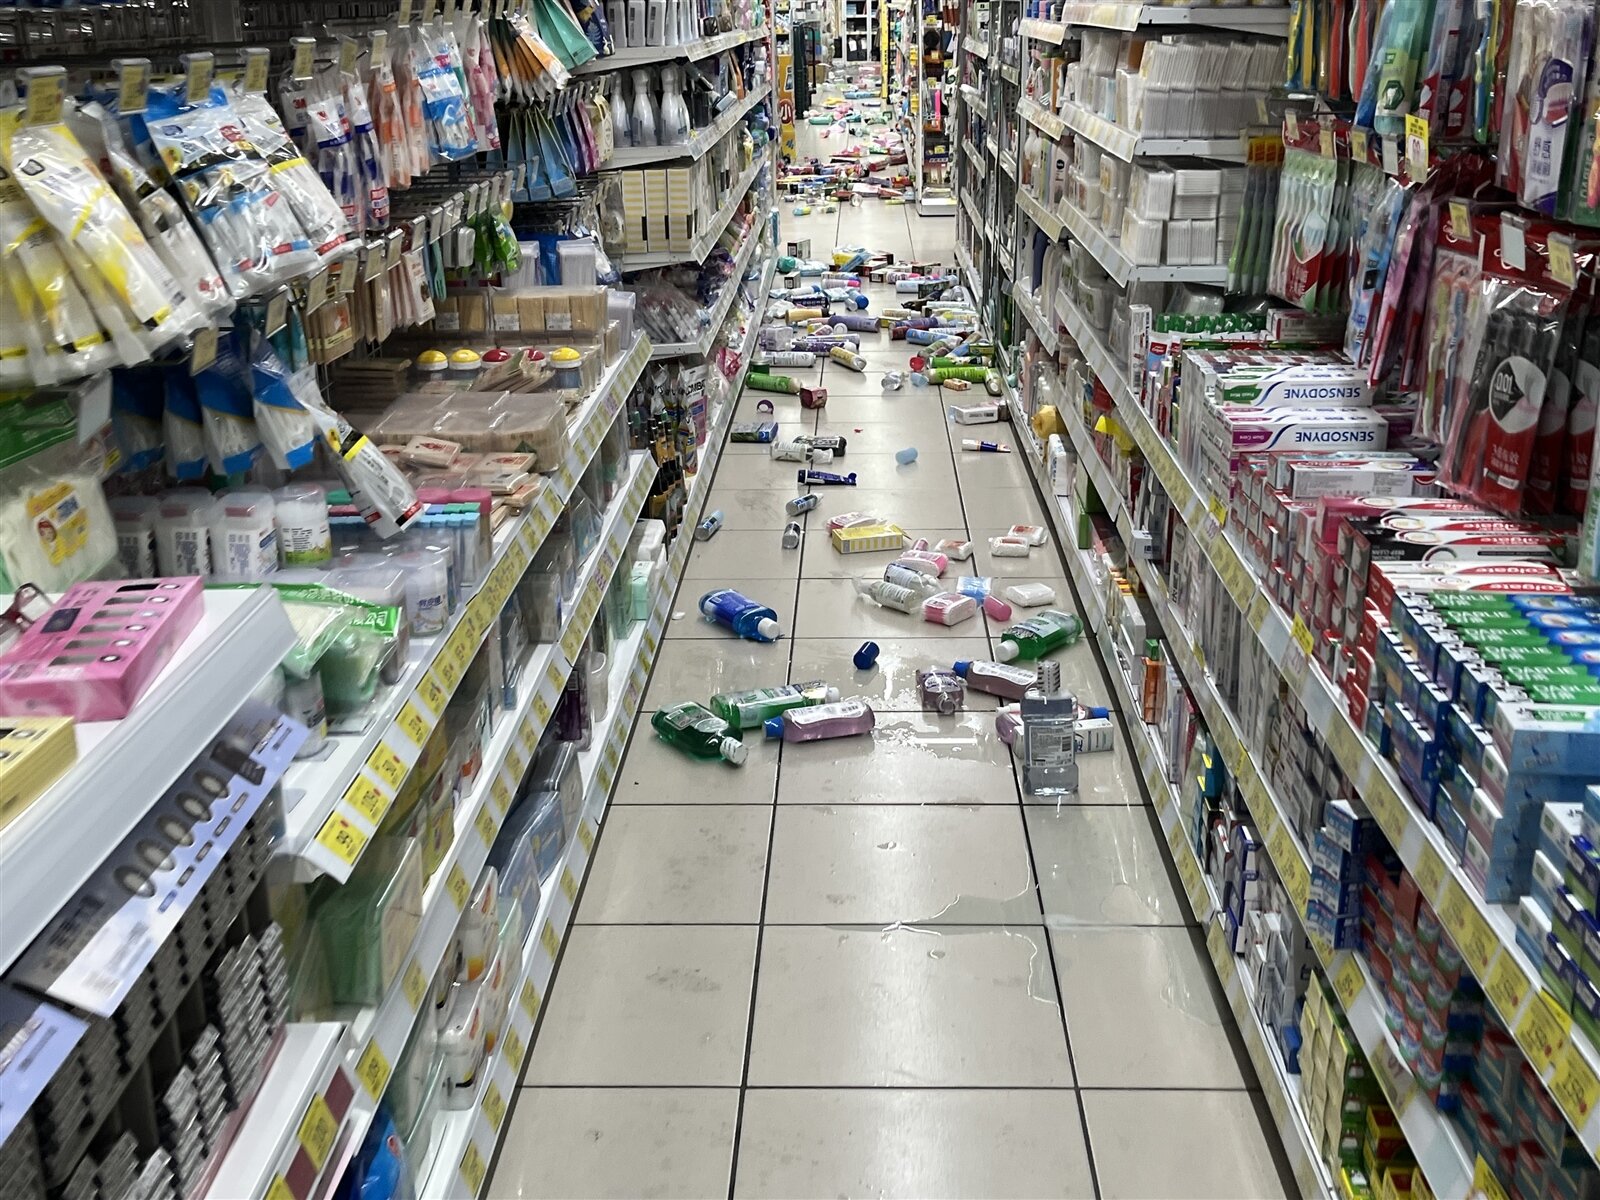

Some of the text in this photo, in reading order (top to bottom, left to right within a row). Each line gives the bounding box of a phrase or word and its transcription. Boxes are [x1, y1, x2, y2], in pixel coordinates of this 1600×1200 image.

[1283, 387, 1361, 399] SENSODYNE
[1295, 431, 1375, 443] SENSODYNE
[1475, 567, 1551, 575] Colgate
[1489, 583, 1567, 592] Colgate
[1433, 593, 1497, 602] DARLIE
[1447, 610, 1512, 619] DARLIE
[1463, 628, 1530, 636] DARLIE
[1484, 646, 1552, 655] DARLIE
[1506, 665, 1577, 676] DARLIE
